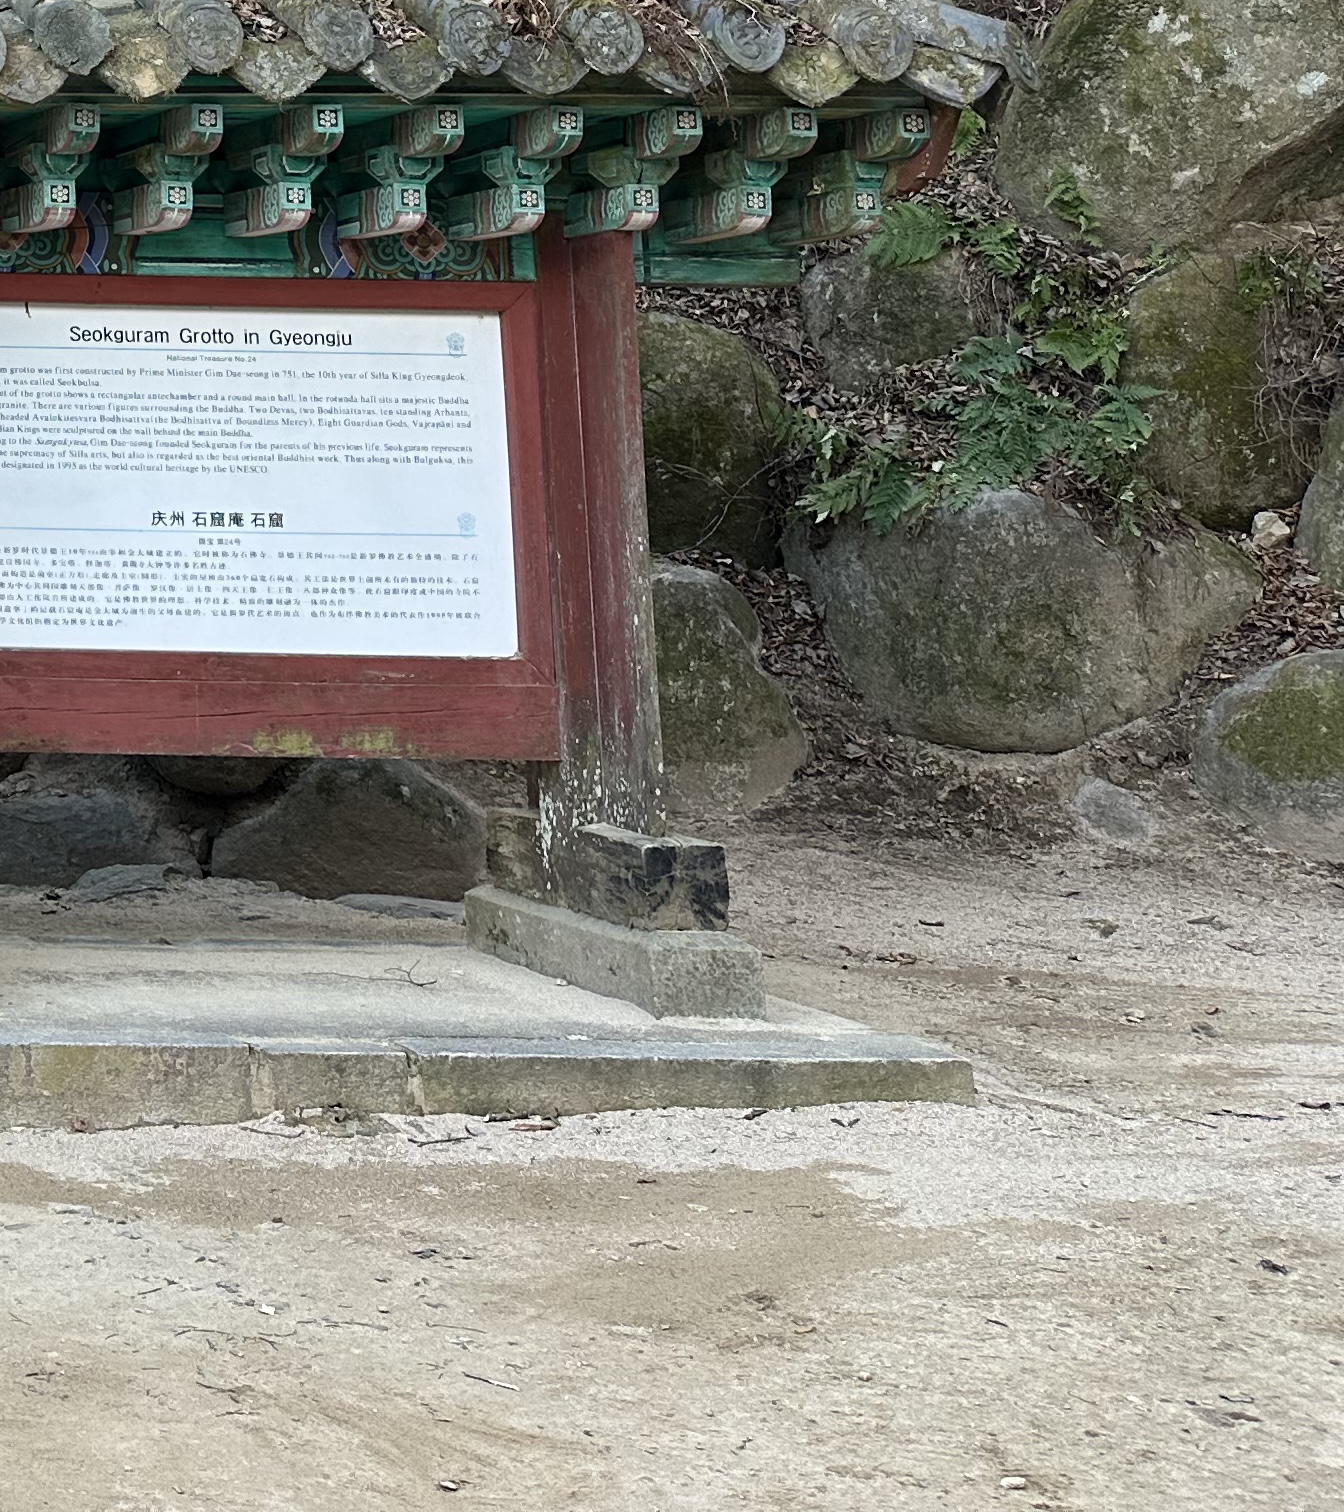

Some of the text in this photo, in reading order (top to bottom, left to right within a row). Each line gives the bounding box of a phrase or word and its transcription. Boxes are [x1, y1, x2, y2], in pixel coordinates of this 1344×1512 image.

[69, 325, 353, 347] Seokguram Grotto in Gyeongju
[391, 371, 413, 381] King
[57, 461, 77, 469] 1995
[151, 510, 185, 527] 庆州
